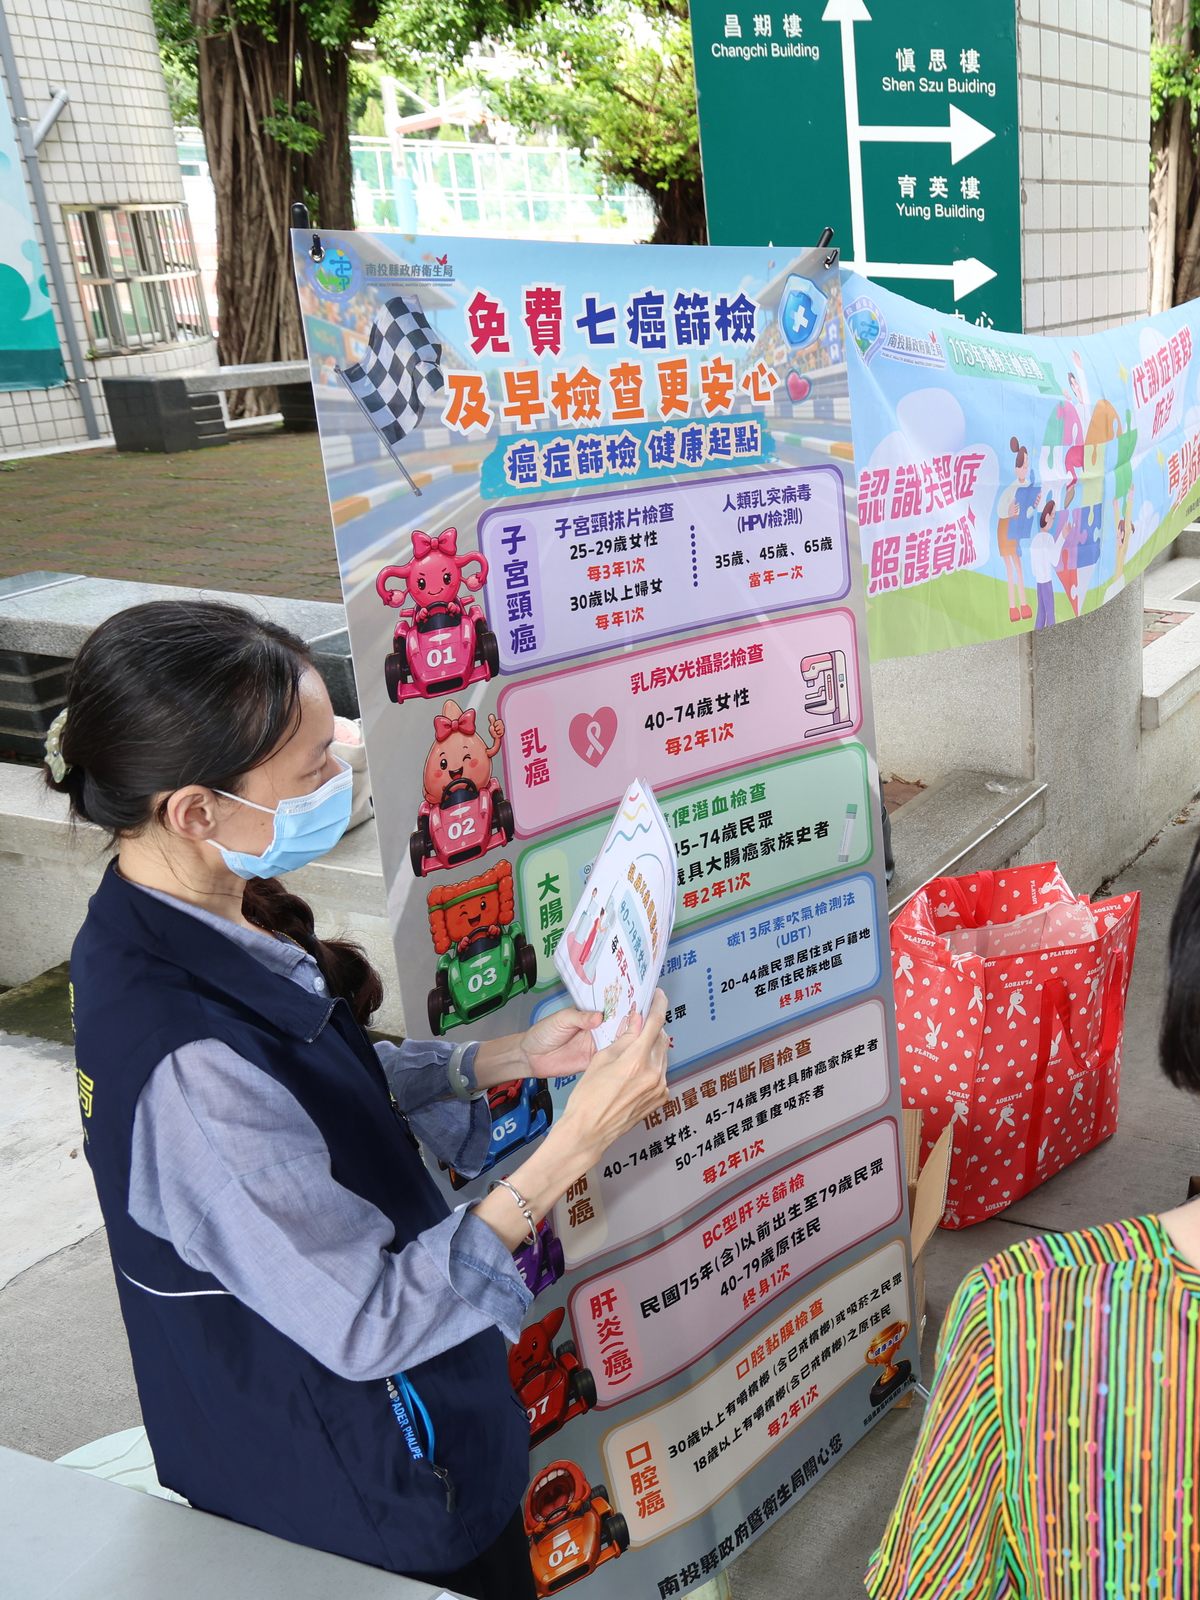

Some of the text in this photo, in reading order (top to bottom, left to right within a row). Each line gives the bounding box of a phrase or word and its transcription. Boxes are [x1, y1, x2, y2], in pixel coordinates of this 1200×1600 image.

[724, 13, 803, 38] 昌期樓
[711, 43, 820, 60] Changchi Building
[882, 77, 996, 97] Shen Szu Buiding
[898, 175, 981, 199] 育英樓
[896, 203, 985, 221] Yuing Building
[467, 287, 757, 357] 免費七癌篩檢
[1131, 324, 1192, 409] 代謝症候群
[445, 356, 780, 431] 及早檢查更安心
[508, 424, 760, 483] 癌症篩檢 健康起點
[722, 484, 812, 513] 人類乳突病毒
[858, 452, 985, 527] 認識失智症
[554, 503, 674, 539] 子宮頸抹片檢查
[737, 507, 803, 533] (HPV檢測)
[570, 530, 658, 560] 25-29歲女性
[869, 514, 977, 592] 照護資源
[587, 557, 645, 582] 每3年1次
[749, 565, 804, 588] 當年一次
[501, 525, 537, 655] 子宮頸癌
[570, 579, 663, 611] 30歲以上婦女
[595, 607, 644, 631] 每年1次
[426, 646, 456, 668] 01
[630, 643, 764, 694] 乳房X光攝影檢查
[644, 688, 750, 731] 40-74歲女性
[665, 722, 734, 756] 每2年1次
[520, 727, 550, 788] 乳癌
[447, 817, 476, 840] 02
[683, 872, 752, 909] 每2年1次
[776, 926, 812, 949] (UBT)
[904, 935, 936, 947] PLAYBOY
[1050, 949, 1077, 957] PLAYBOY
[467, 967, 498, 994] 03
[754, 954, 843, 998] 在原住民族地區
[1004, 980, 1032, 989] PLAYBOY
[779, 982, 822, 1009] 終身1次
[914, 1048, 939, 1063] PLAYBOY
[995, 1092, 1023, 1104] PLAYBOY
[493, 1117, 517, 1142] 05
[702, 1140, 766, 1185] 每2年1次
[702, 1172, 805, 1249] BC型肝炎篩檢
[720, 1217, 821, 1297] 40-79歲原住民
[741, 1263, 791, 1310] 終身1次
[735, 1297, 824, 1381] 口腔黏膜檢查
[392, 1396, 408, 1427] PADER
[767, 1384, 819, 1438] 每2年1次
[625, 1440, 666, 1520] 口腔癌
[657, 1432, 843, 1600] 南投縣政府暨衛生局關心您
[548, 1541, 580, 1569] 04
